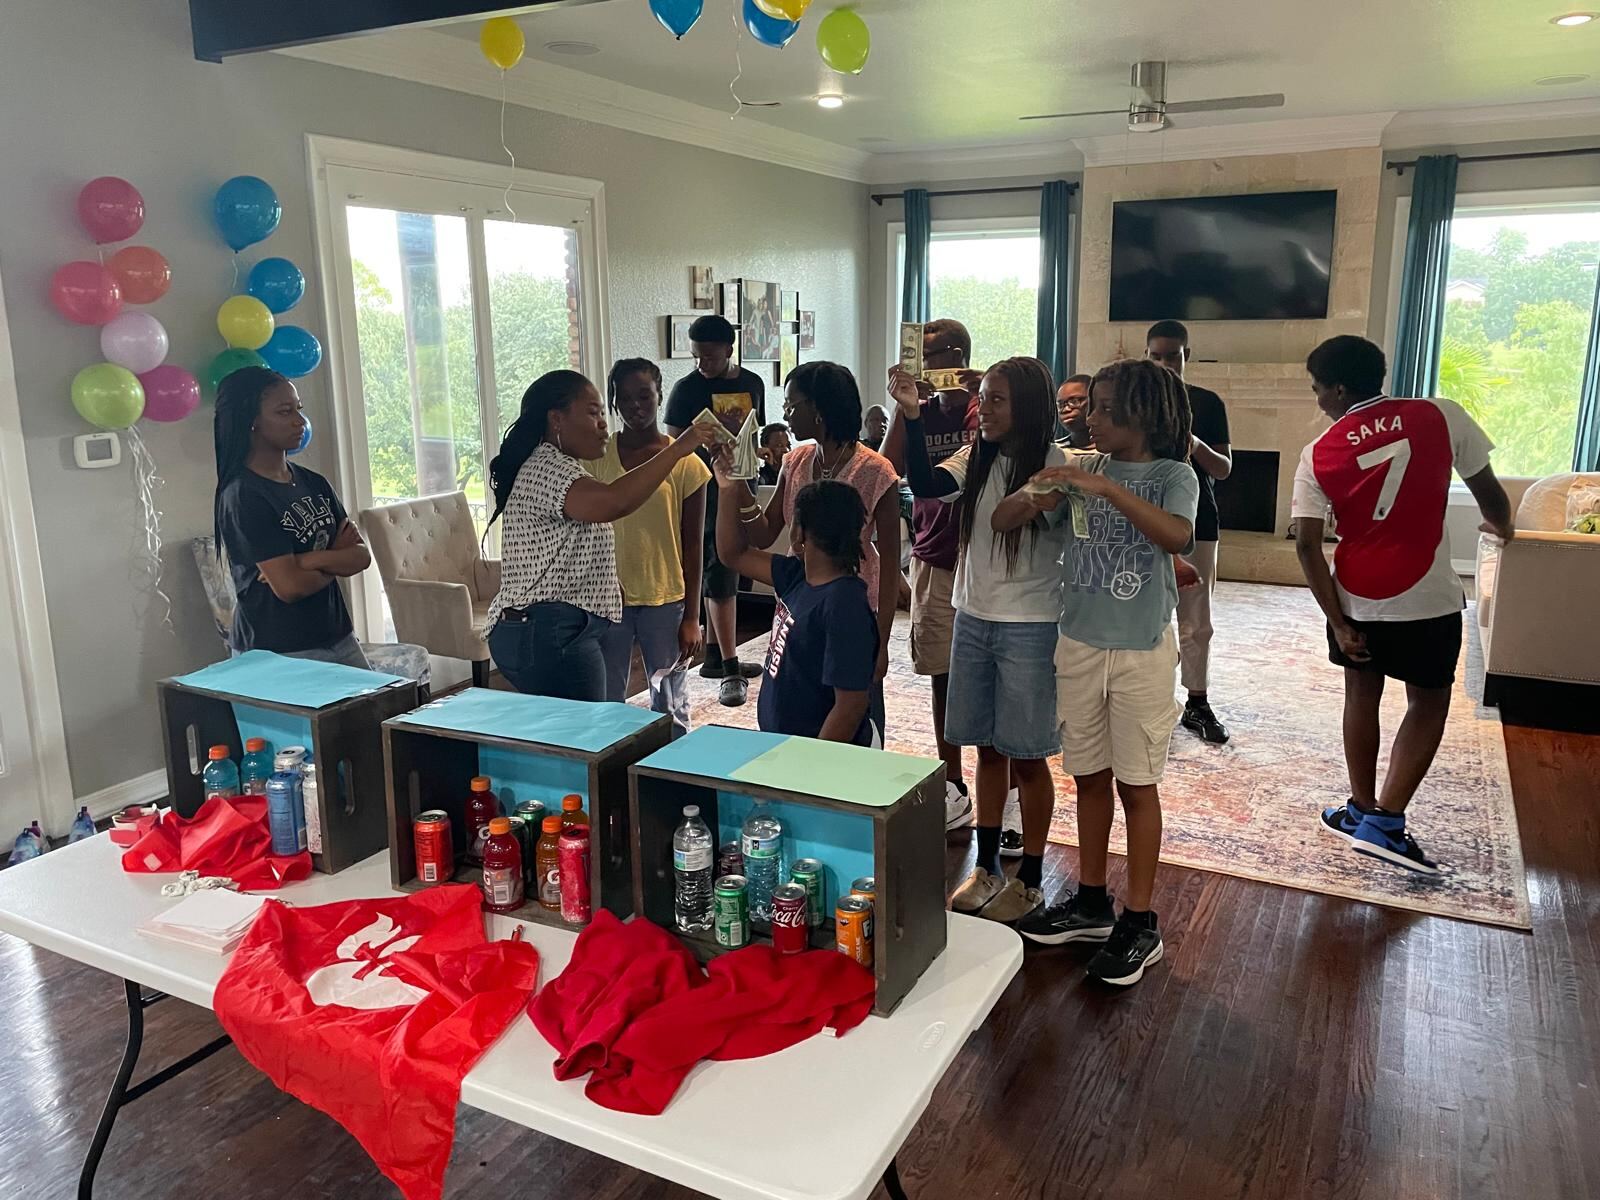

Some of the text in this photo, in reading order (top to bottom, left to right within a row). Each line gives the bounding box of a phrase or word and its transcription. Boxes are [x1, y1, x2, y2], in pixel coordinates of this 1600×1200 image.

[925, 430, 978, 447] DOCKER
[1346, 415, 1403, 446] SAKA
[1356, 438, 1412, 520] 7
[1069, 542, 1154, 588] NYC
[768, 615, 795, 679] USWNT
